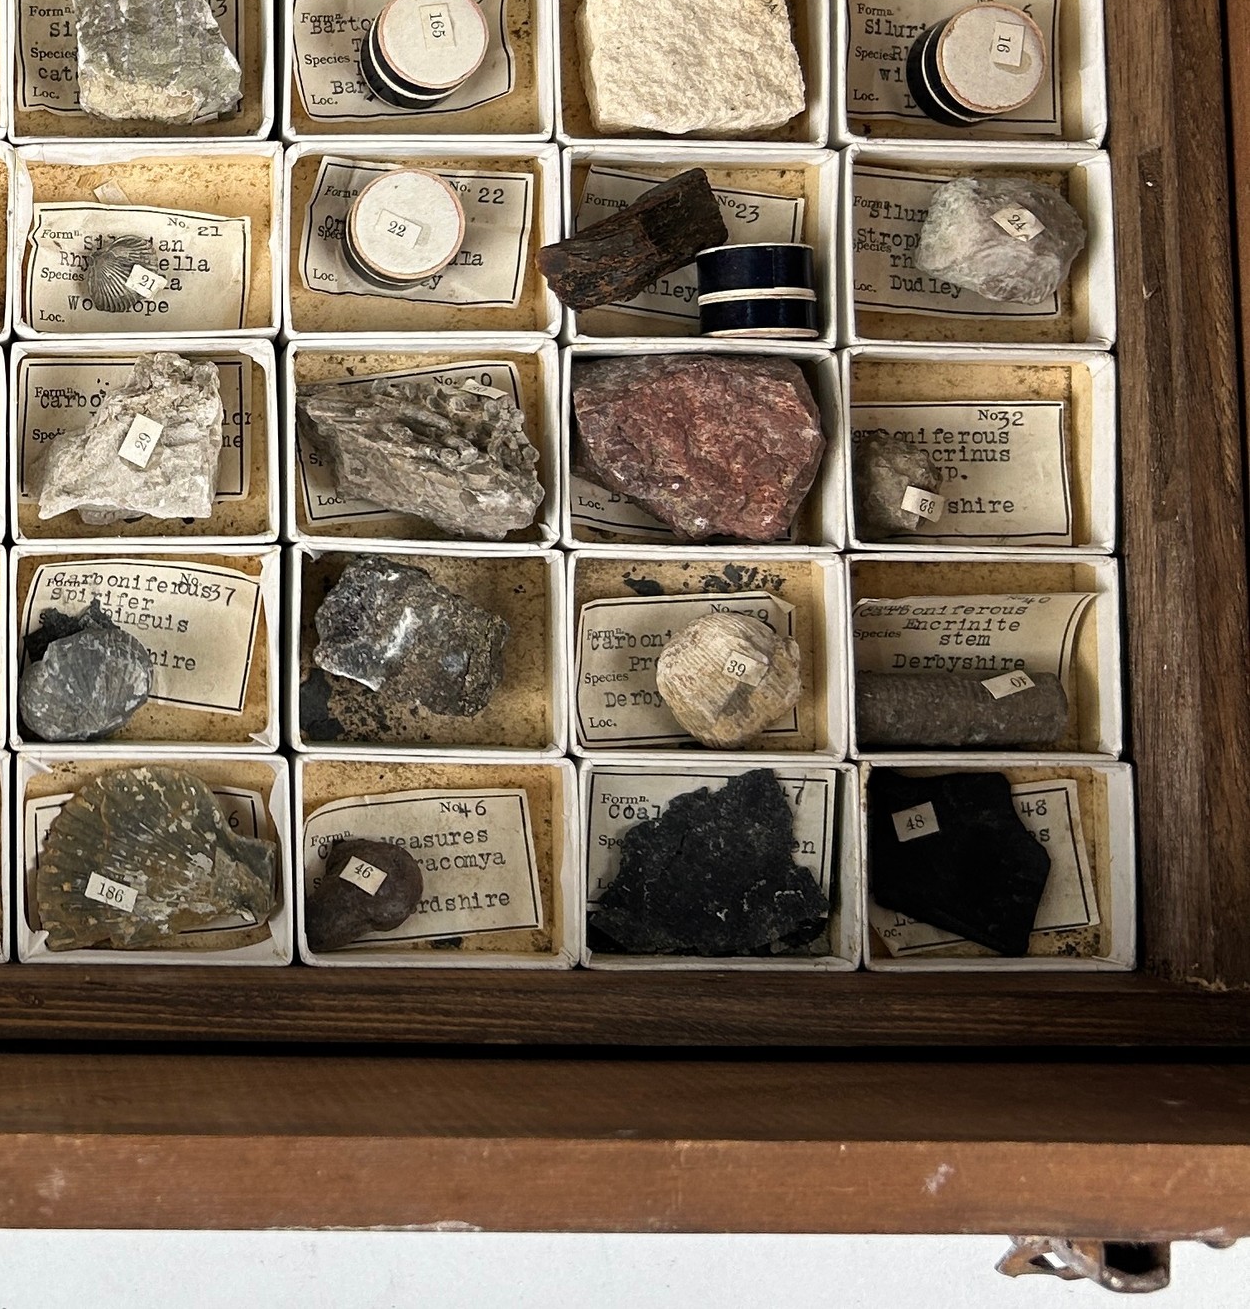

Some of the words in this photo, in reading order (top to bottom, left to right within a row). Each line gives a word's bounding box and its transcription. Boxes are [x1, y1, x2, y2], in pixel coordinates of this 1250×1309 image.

[428, 10, 447, 39] 165
[854, 45, 894, 61] Species
[996, 35, 1011, 54] 16
[304, 52, 350, 68] Species
[32, 86, 60, 100] Loc.
[311, 93, 338, 106] Loc.
[853, 88, 879, 102] Loc.
[477, 187, 505, 205] 22
[735, 203, 761, 224] 23
[166, 217, 190, 230] No.
[197, 226, 223, 237] 21
[387, 220, 407, 237] 22
[1007, 214, 1027, 232] 24
[40, 268, 84, 282] Species
[140, 274, 156, 290] 21
[313, 268, 338, 282] Loc.
[890, 274, 962, 299] Dudley
[40, 310, 65, 323] Loc.
[432, 374, 458, 386] No.
[996, 411, 1025, 431] 32
[134, 431, 152, 452] 29
[316, 494, 347, 507] Loc.
[578, 496, 606, 511] Loc.
[918, 497, 936, 514] 32
[52, 571, 212, 599] Carboniferous
[208, 583, 237, 607] 37
[50, 587, 155, 611] Spirifer
[860, 604, 1029, 618] Carboniferous
[902, 617, 1021, 632] Encrinite
[852, 628, 902, 641] Species
[939, 632, 991, 647] stem
[726, 660, 747, 677] 39
[892, 653, 1026, 673] Derbyshire
[584, 672, 629, 690] Species
[589, 716, 617, 728] Loc.
[457, 799, 488, 817] 46
[607, 804, 661, 820] Coal
[1021, 798, 1048, 817] 48
[906, 814, 925, 831] 48
[353, 863, 374, 880] 46
[97, 882, 126, 903] 186
